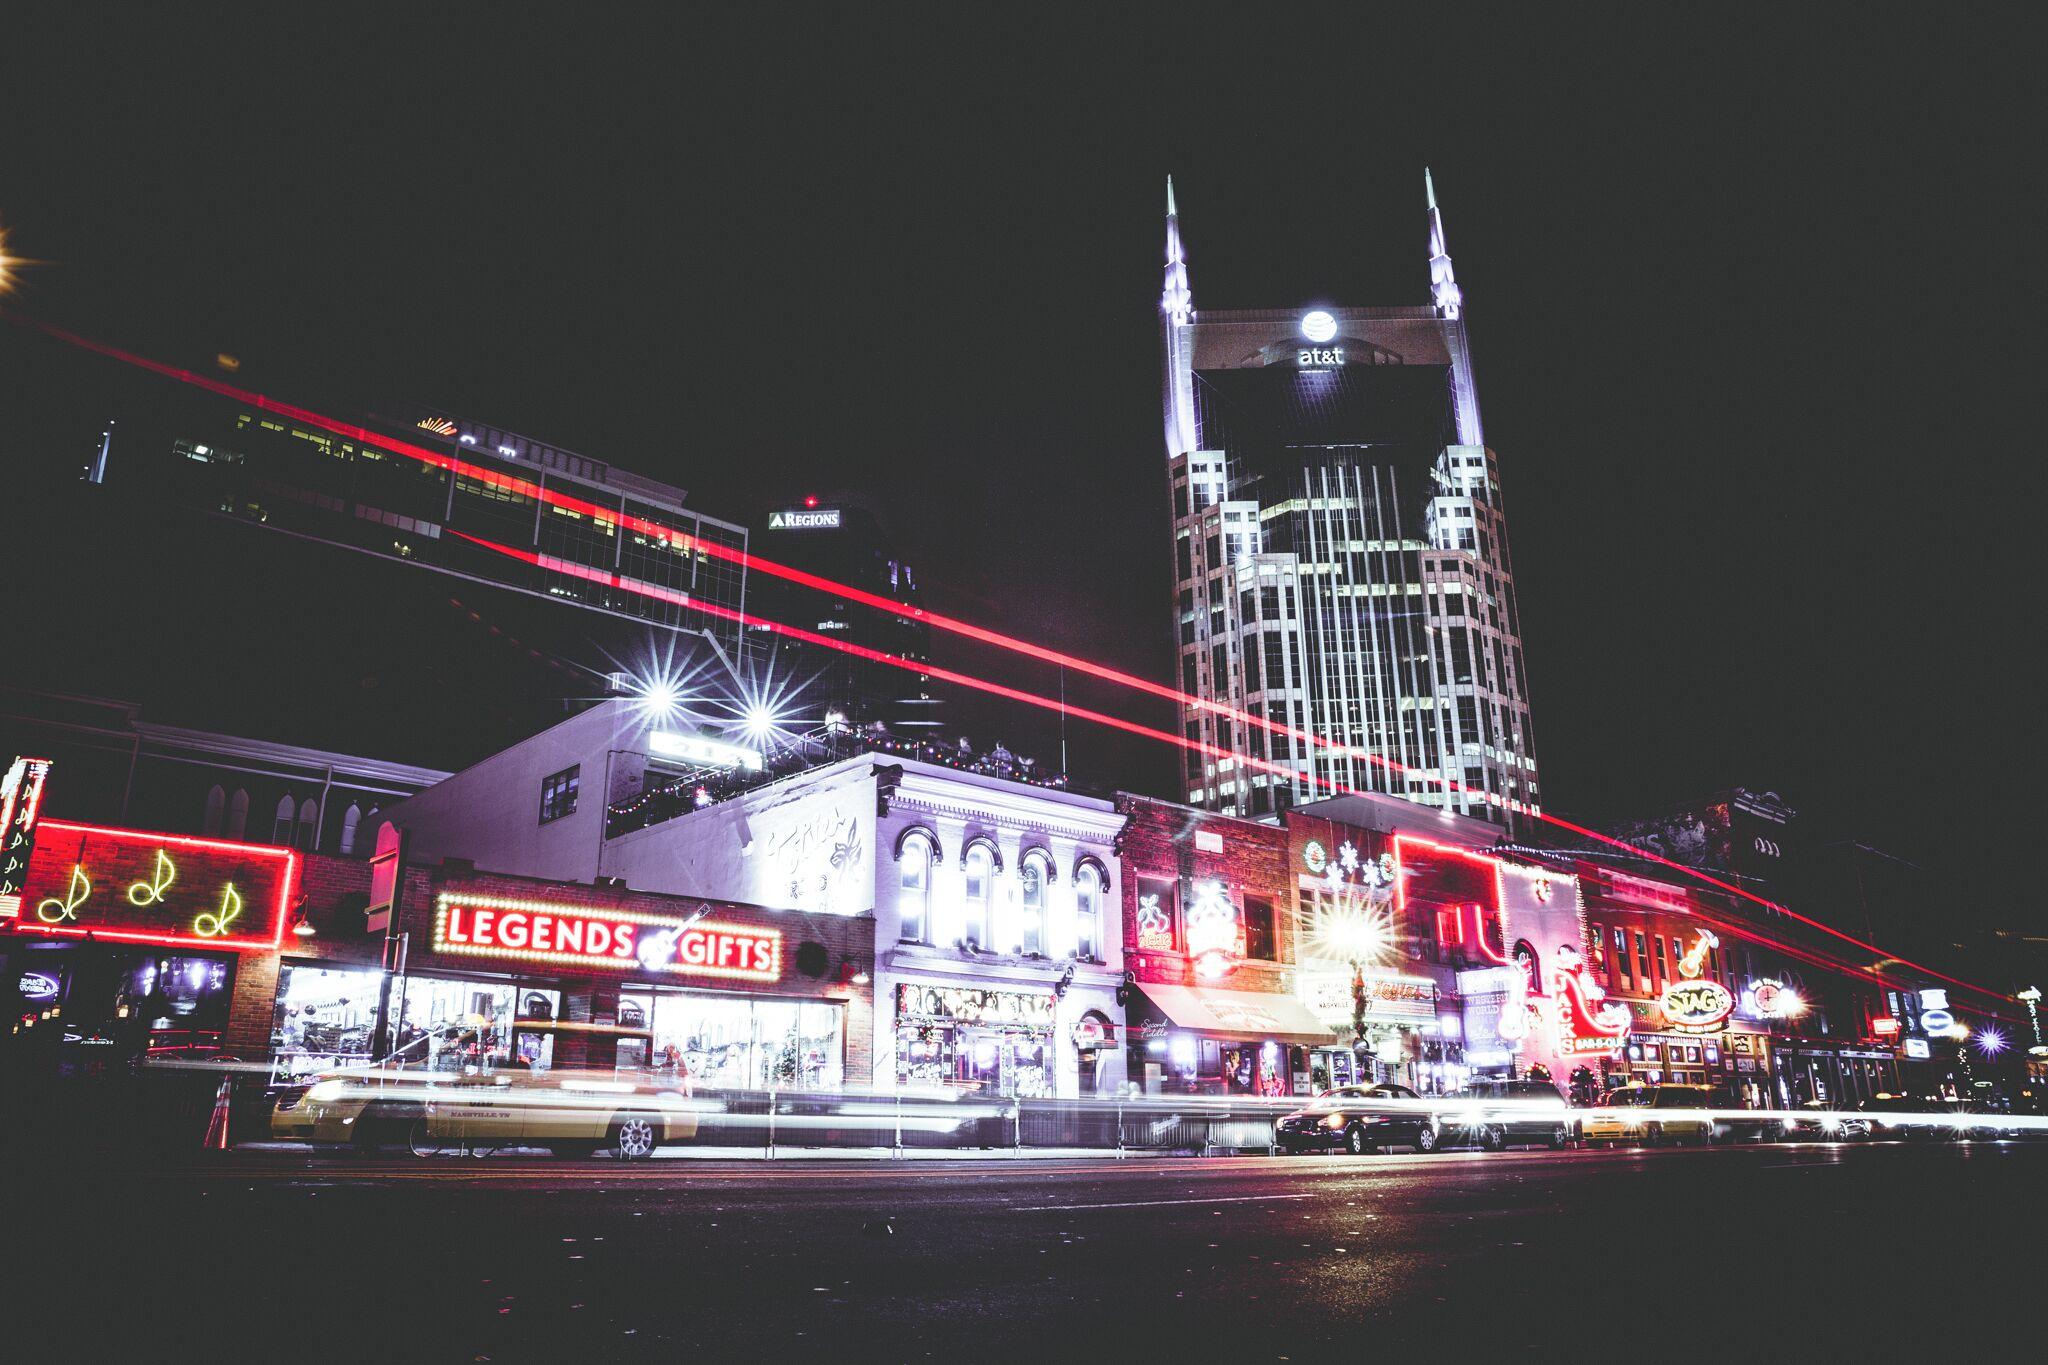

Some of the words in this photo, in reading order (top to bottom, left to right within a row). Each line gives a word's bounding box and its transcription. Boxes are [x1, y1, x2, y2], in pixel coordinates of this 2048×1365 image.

[1299, 347, 1345, 365] at&t
[448, 907, 634, 958] LEGENDS
[680, 931, 772, 971] GIFTS
[1666, 989, 1727, 1014] STAGE
[1141, 1019, 1168, 1030] Second
